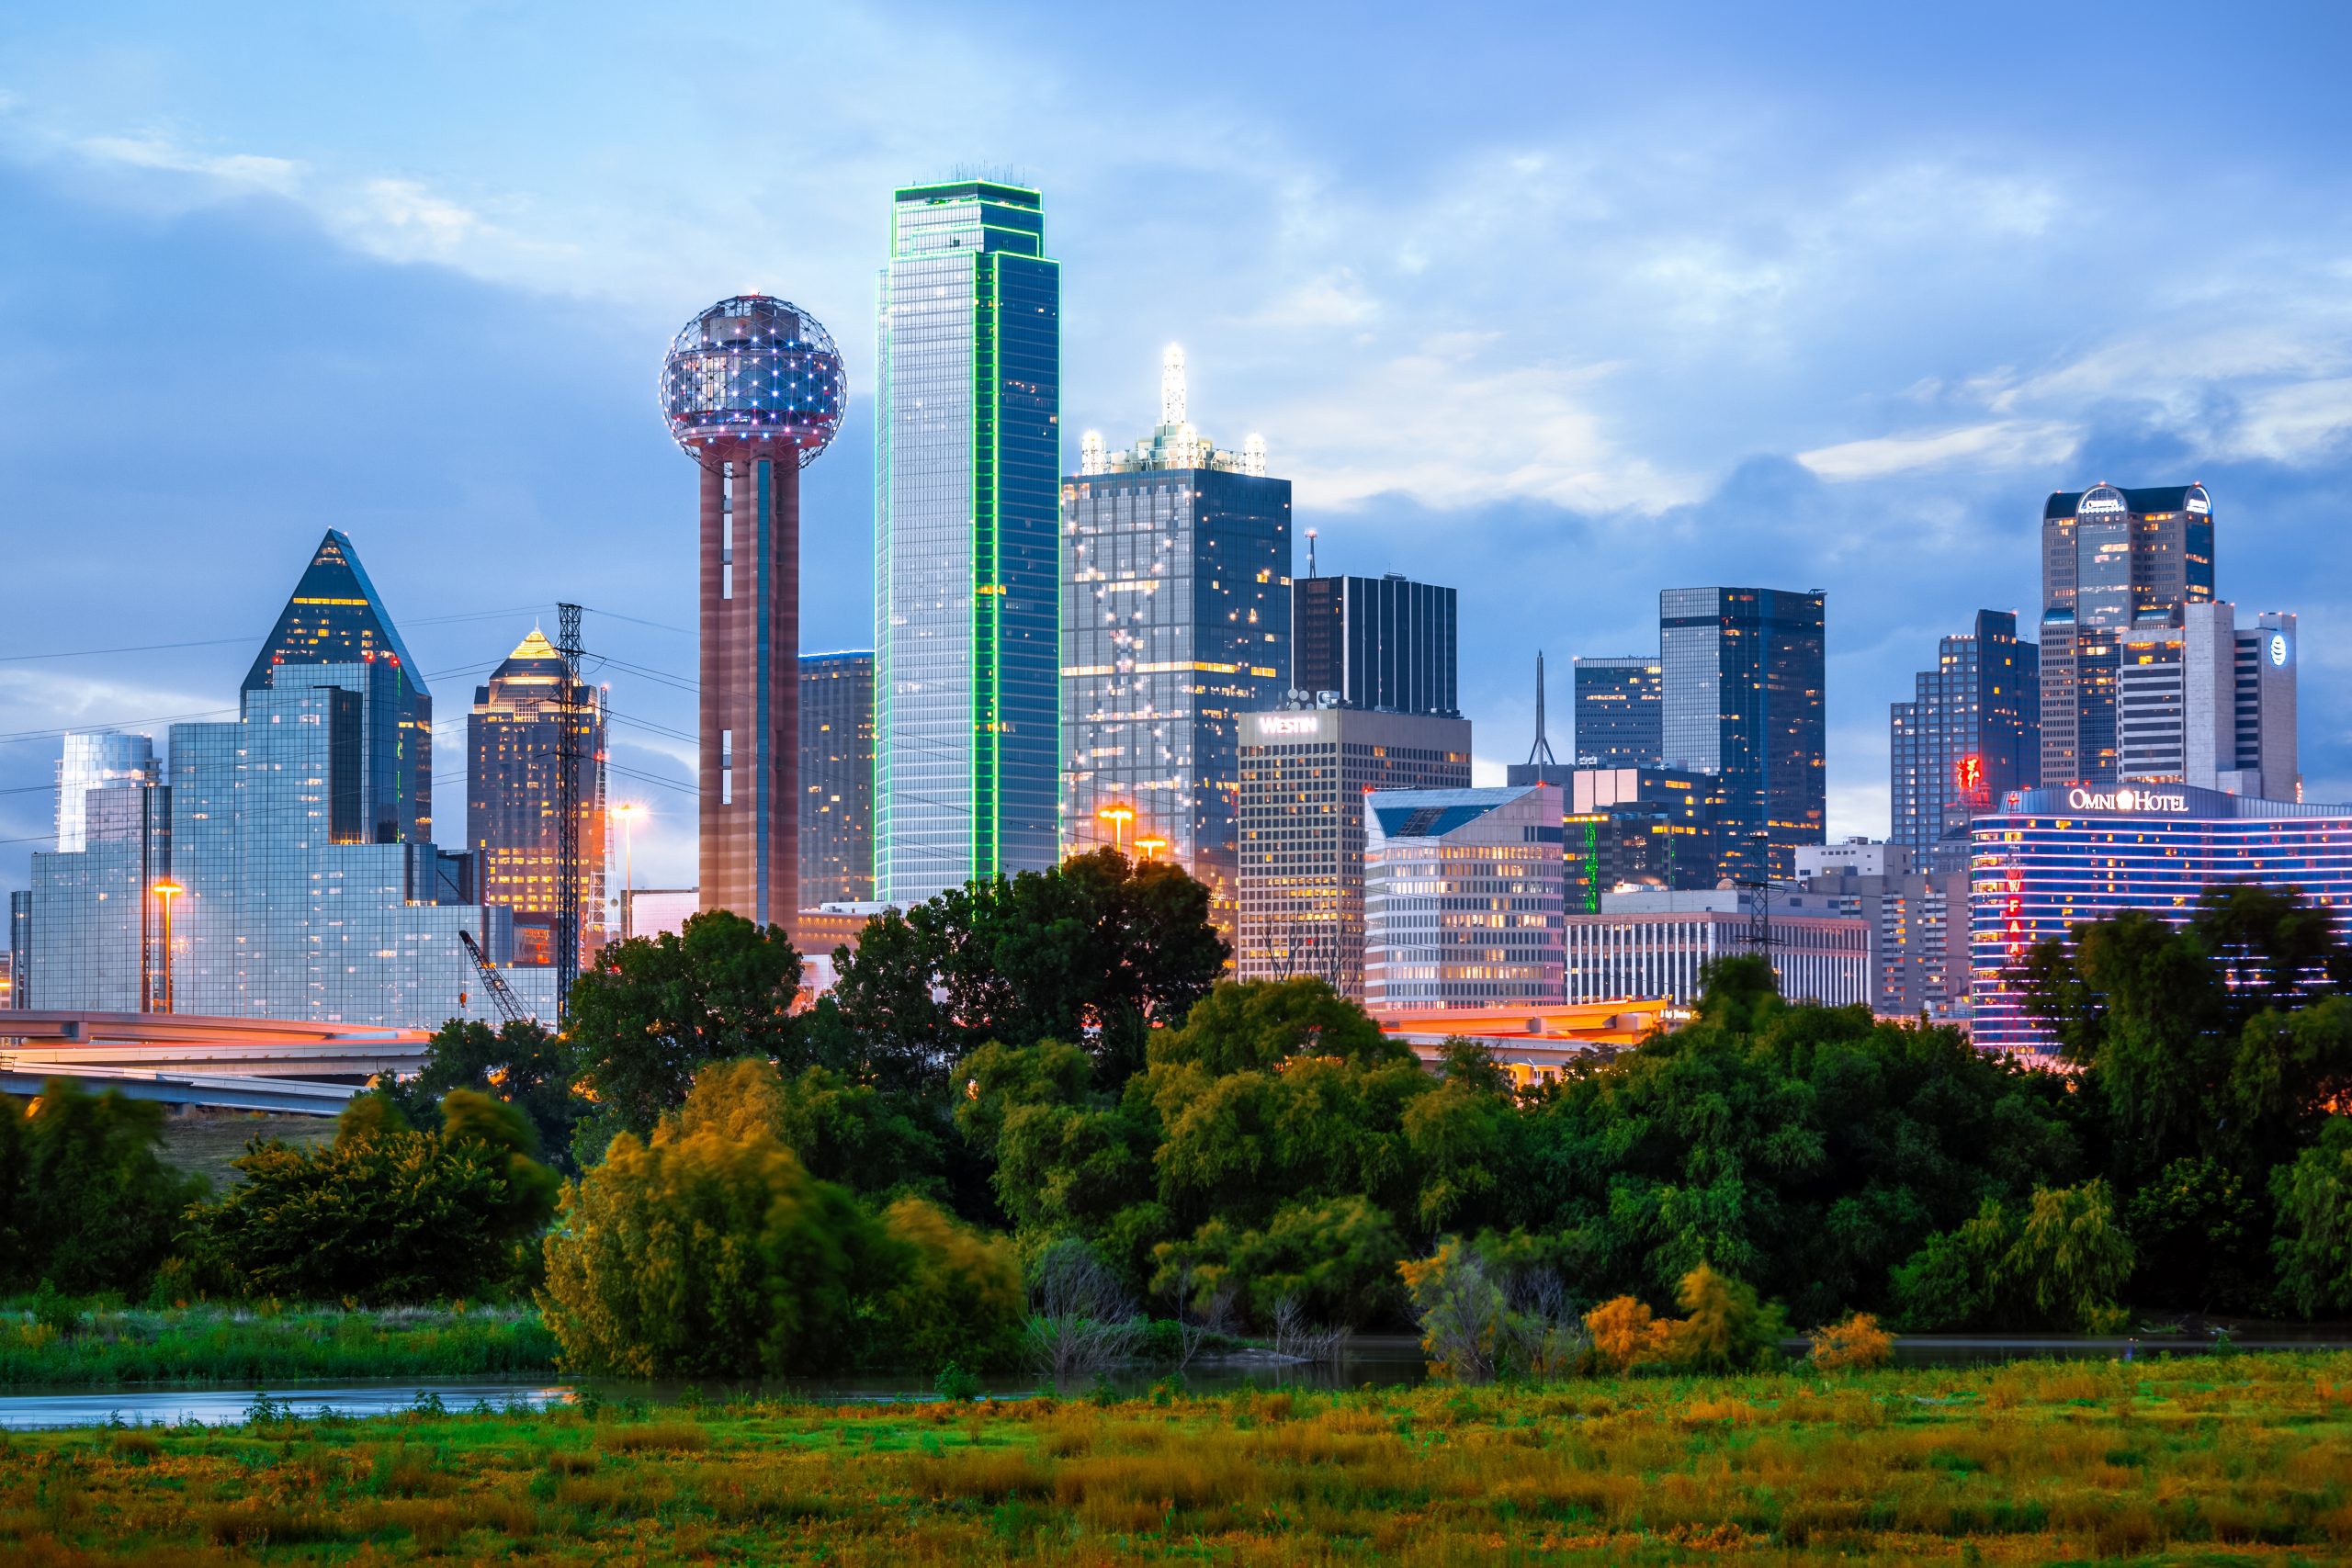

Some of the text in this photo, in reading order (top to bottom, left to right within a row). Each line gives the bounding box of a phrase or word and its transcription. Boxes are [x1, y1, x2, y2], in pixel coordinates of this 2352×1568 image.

[1259, 716, 1317, 734] WESTIN
[2069, 789, 2189, 812] OMNI HOTEL
[2008, 879, 2021, 953] WFAA
